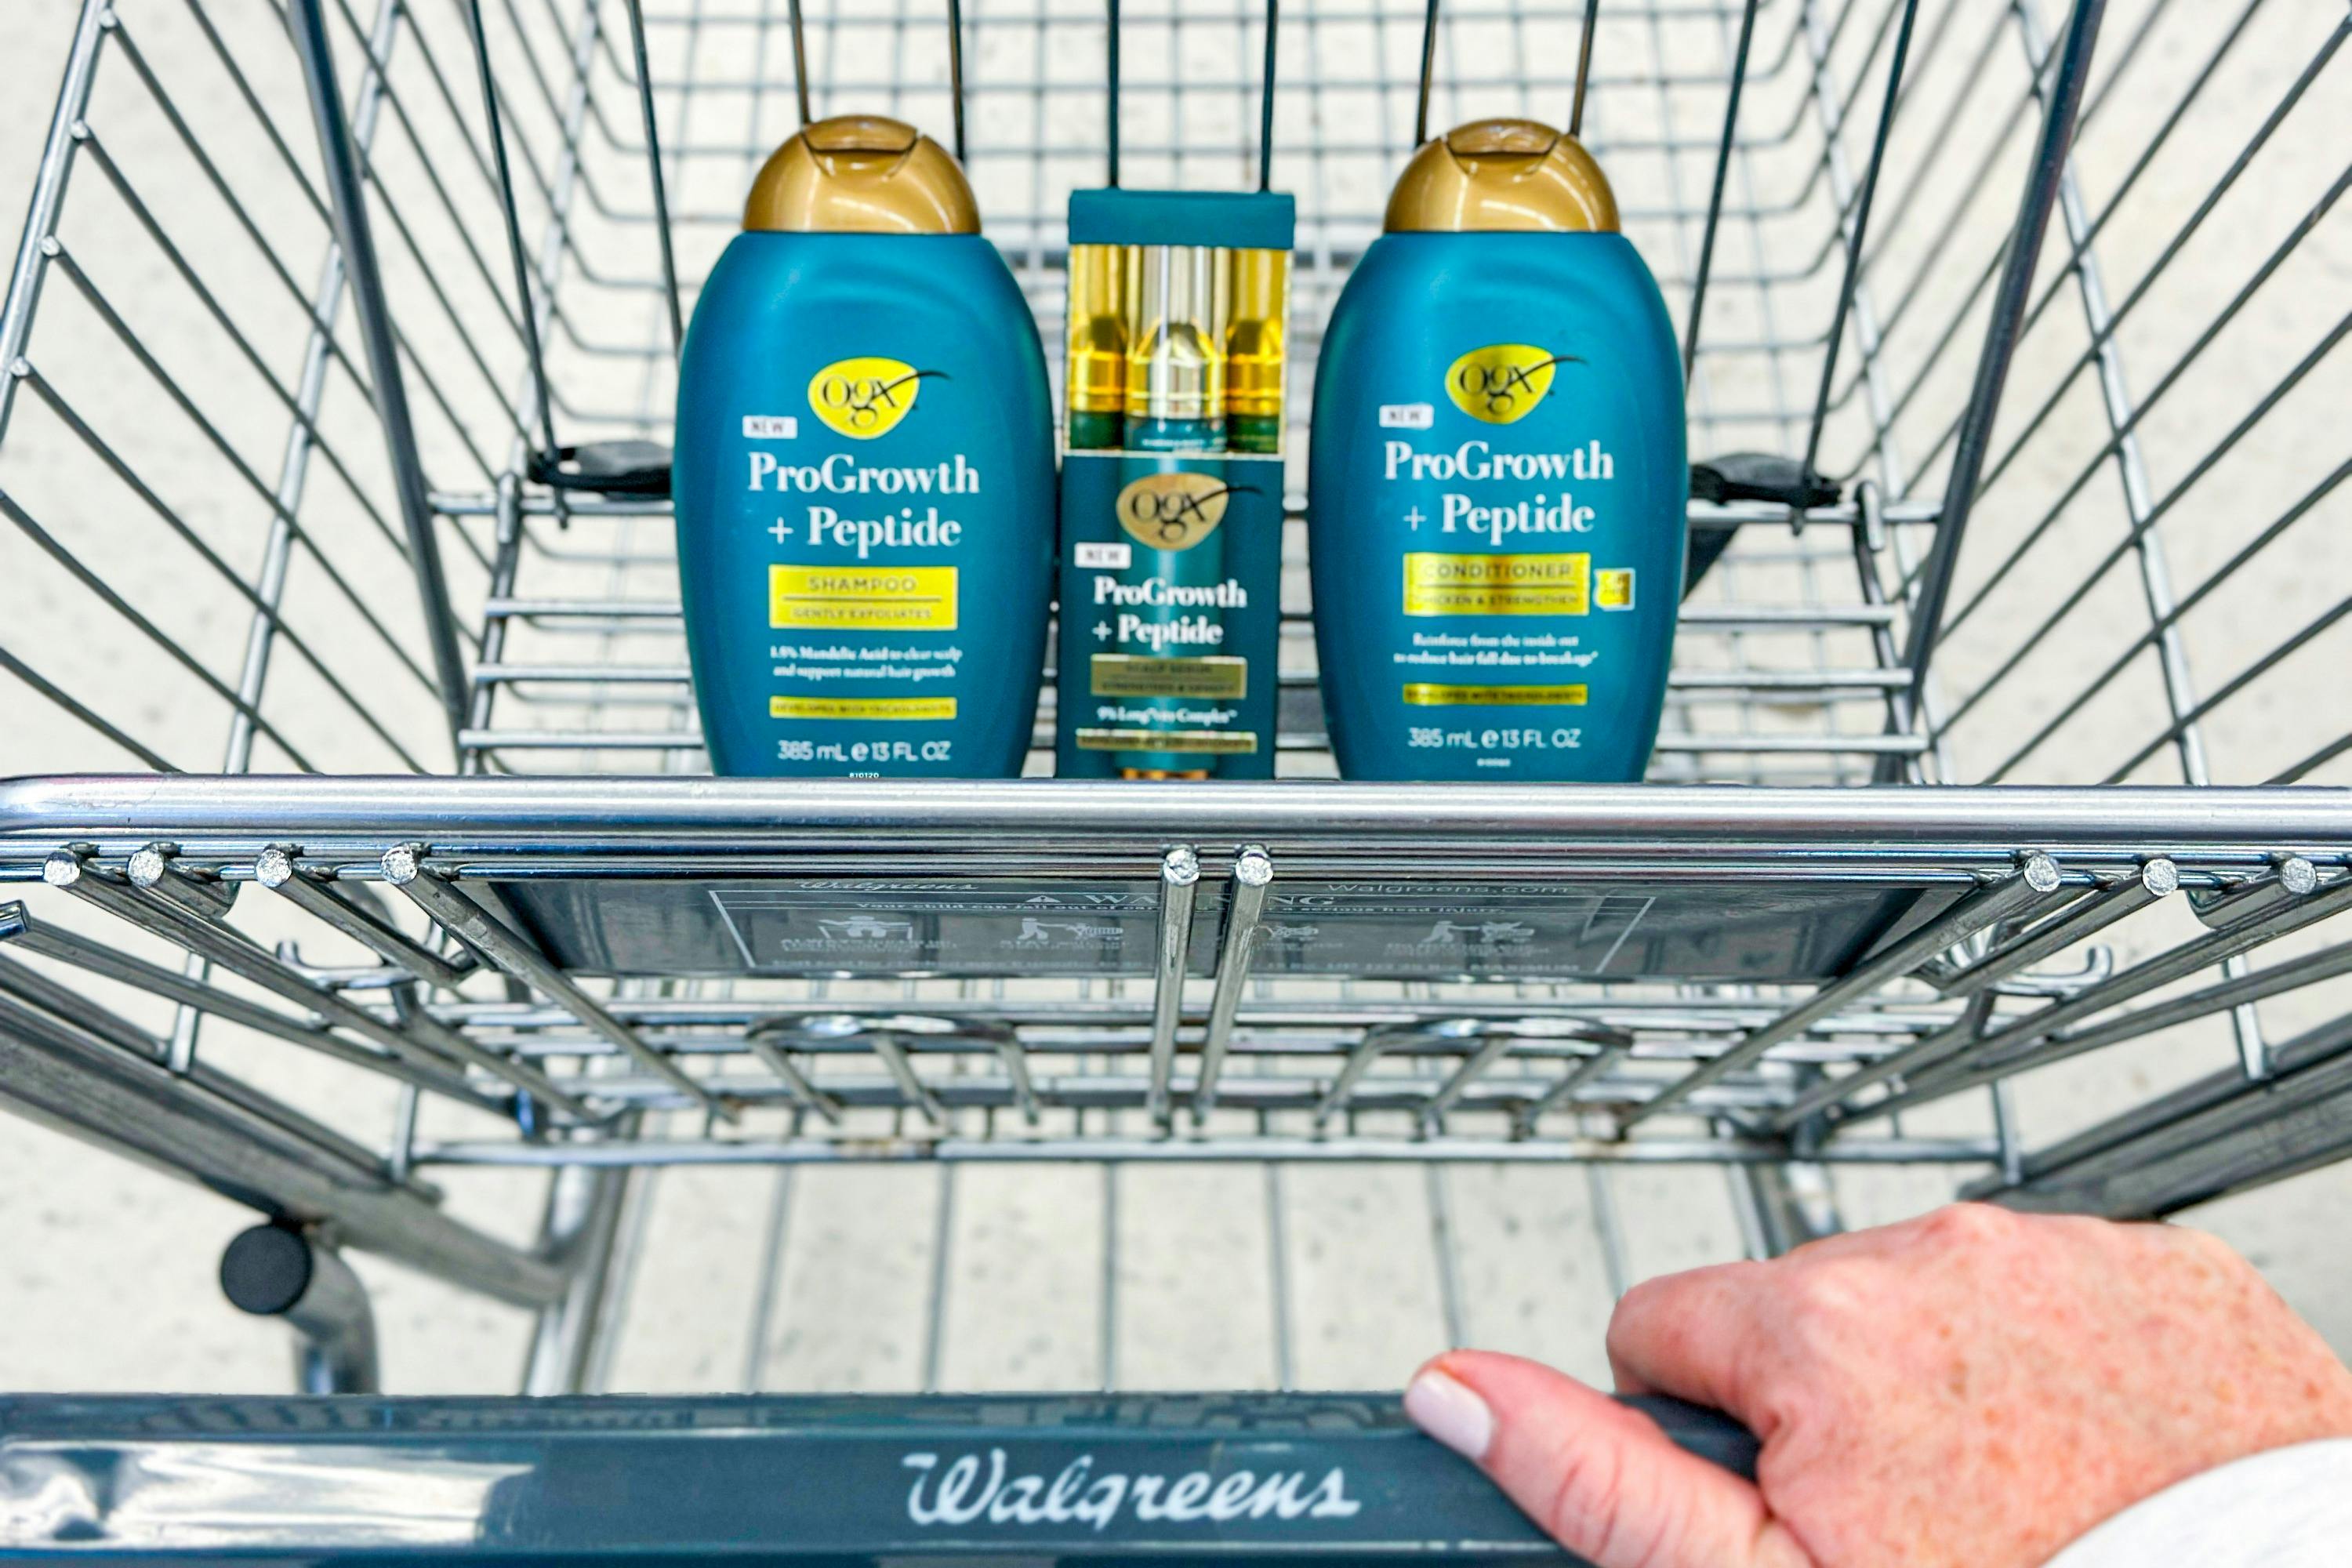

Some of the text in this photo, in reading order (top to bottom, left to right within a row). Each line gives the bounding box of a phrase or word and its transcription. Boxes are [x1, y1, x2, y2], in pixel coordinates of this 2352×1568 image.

[752, 419, 785, 434] NEW
[748, 452, 979, 493] ProGrowth
[1385, 440, 1613, 480] ProGrowth
[768, 506, 961, 558] + Peptide
[1403, 493, 1595, 546] + Peptide
[808, 576, 917, 591] SHAMPOO
[1094, 575, 1247, 608] ProGrowth
[1091, 614, 1224, 652] + Peptide
[778, 740, 814, 760] 385
[817, 743, 848, 761] mL
[872, 742, 890, 761] 13
[893, 742, 918, 761] FL
[921, 741, 951, 760] OZ
[1408, 728, 1443, 747] 385
[1446, 730, 1478, 748] mL
[1501, 729, 1520, 748] 13
[1523, 729, 1547, 748] FL
[1552, 728, 1581, 748] OZ
[795, 880, 979, 891] Walgreens
[1328, 884, 1569, 894] Walgreens.com
[902, 1448, 1361, 1530] Walgreens
